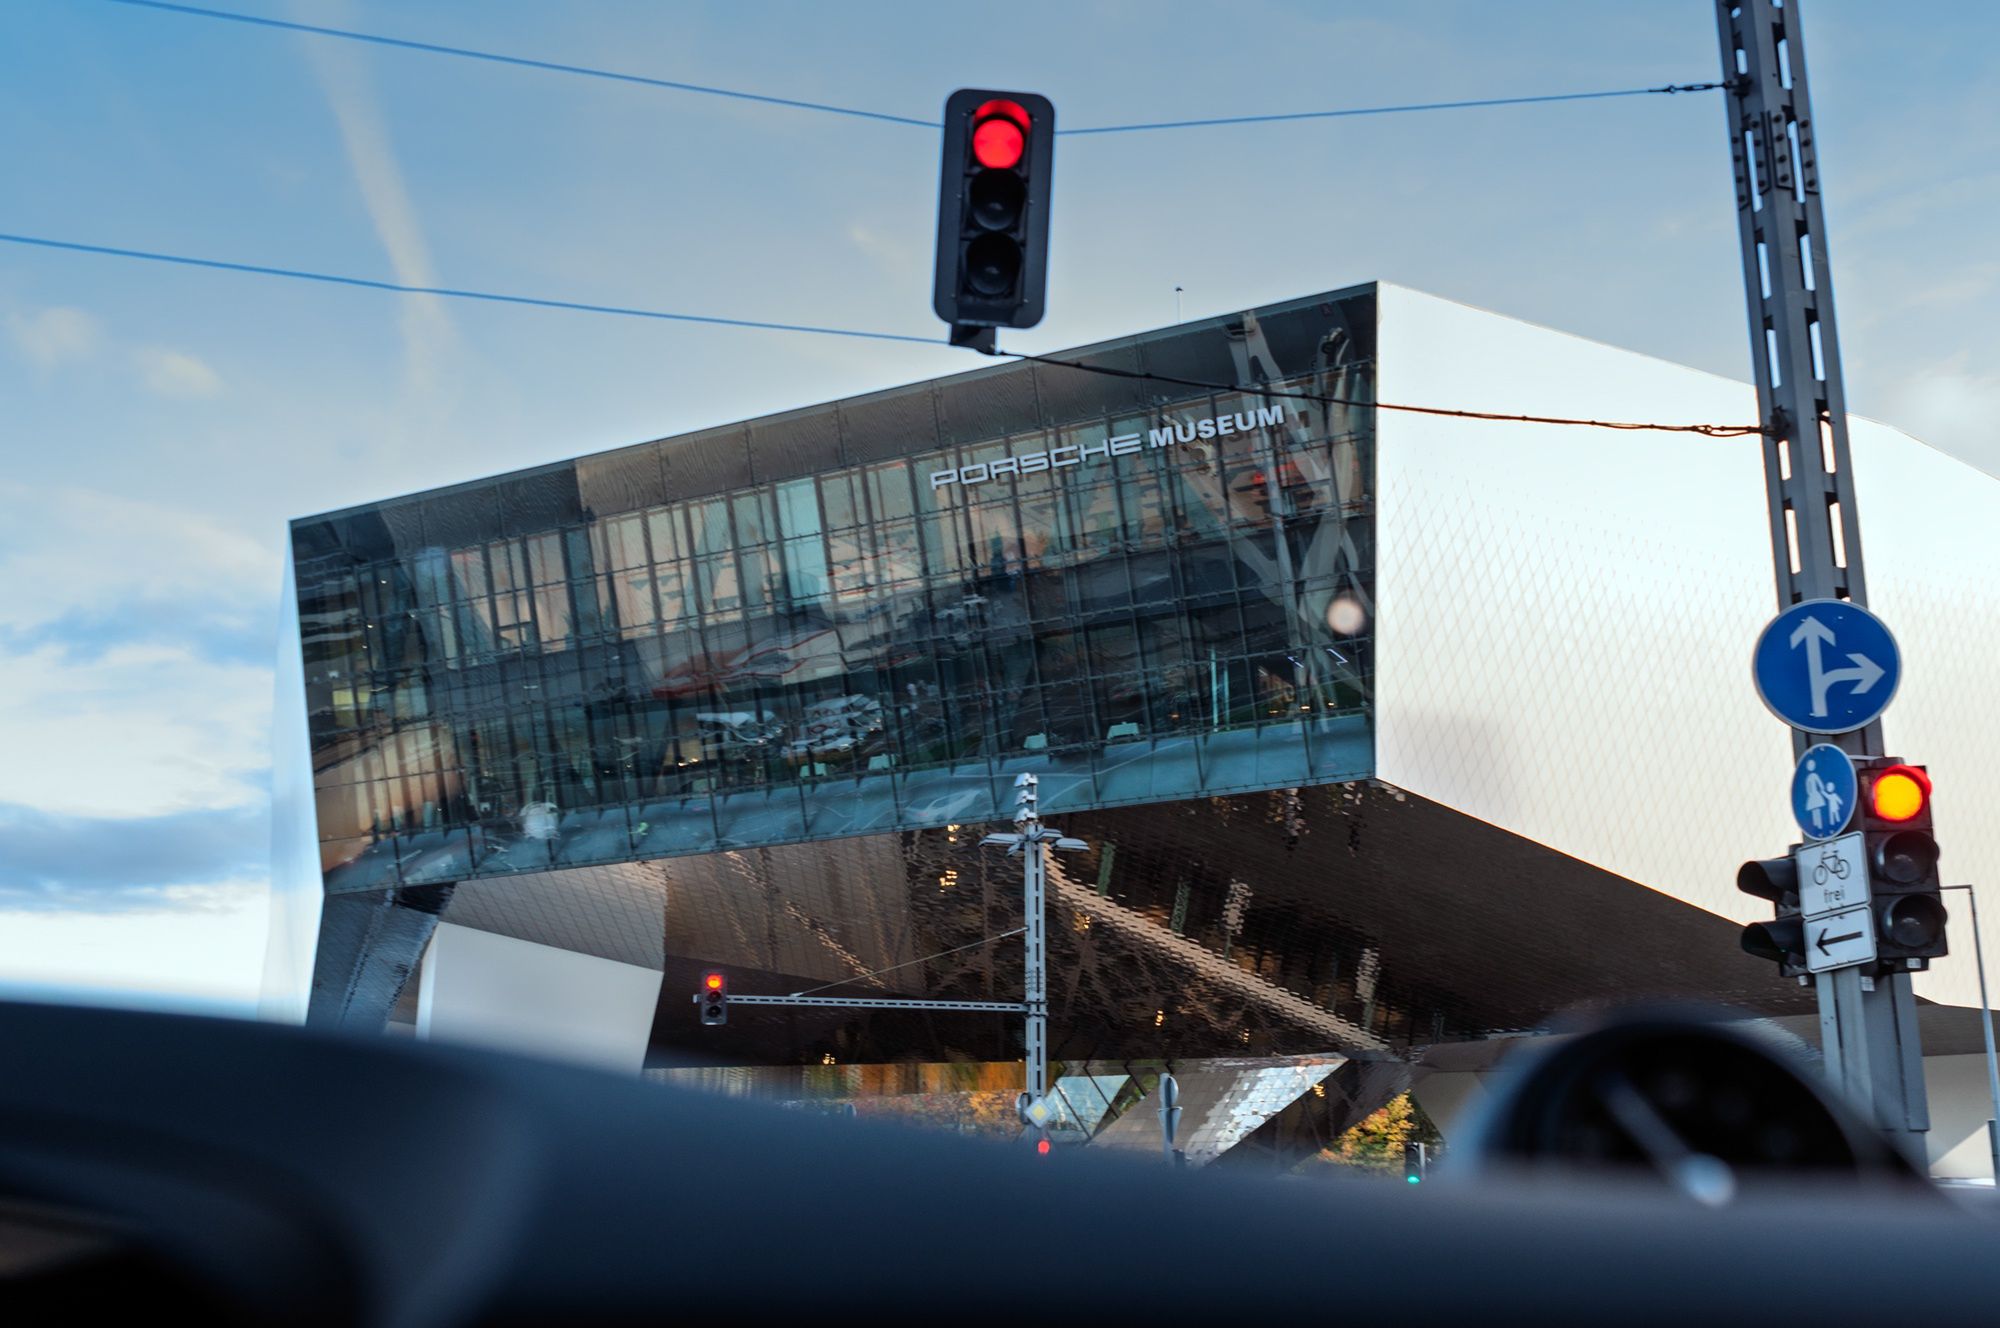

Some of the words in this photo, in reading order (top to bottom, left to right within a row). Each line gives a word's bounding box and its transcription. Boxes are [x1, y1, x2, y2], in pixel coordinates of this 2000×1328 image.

[929, 432, 1143, 490] PORSCHE
[1149, 404, 1285, 449] MUSEUM
[1823, 885, 1846, 904] frei
